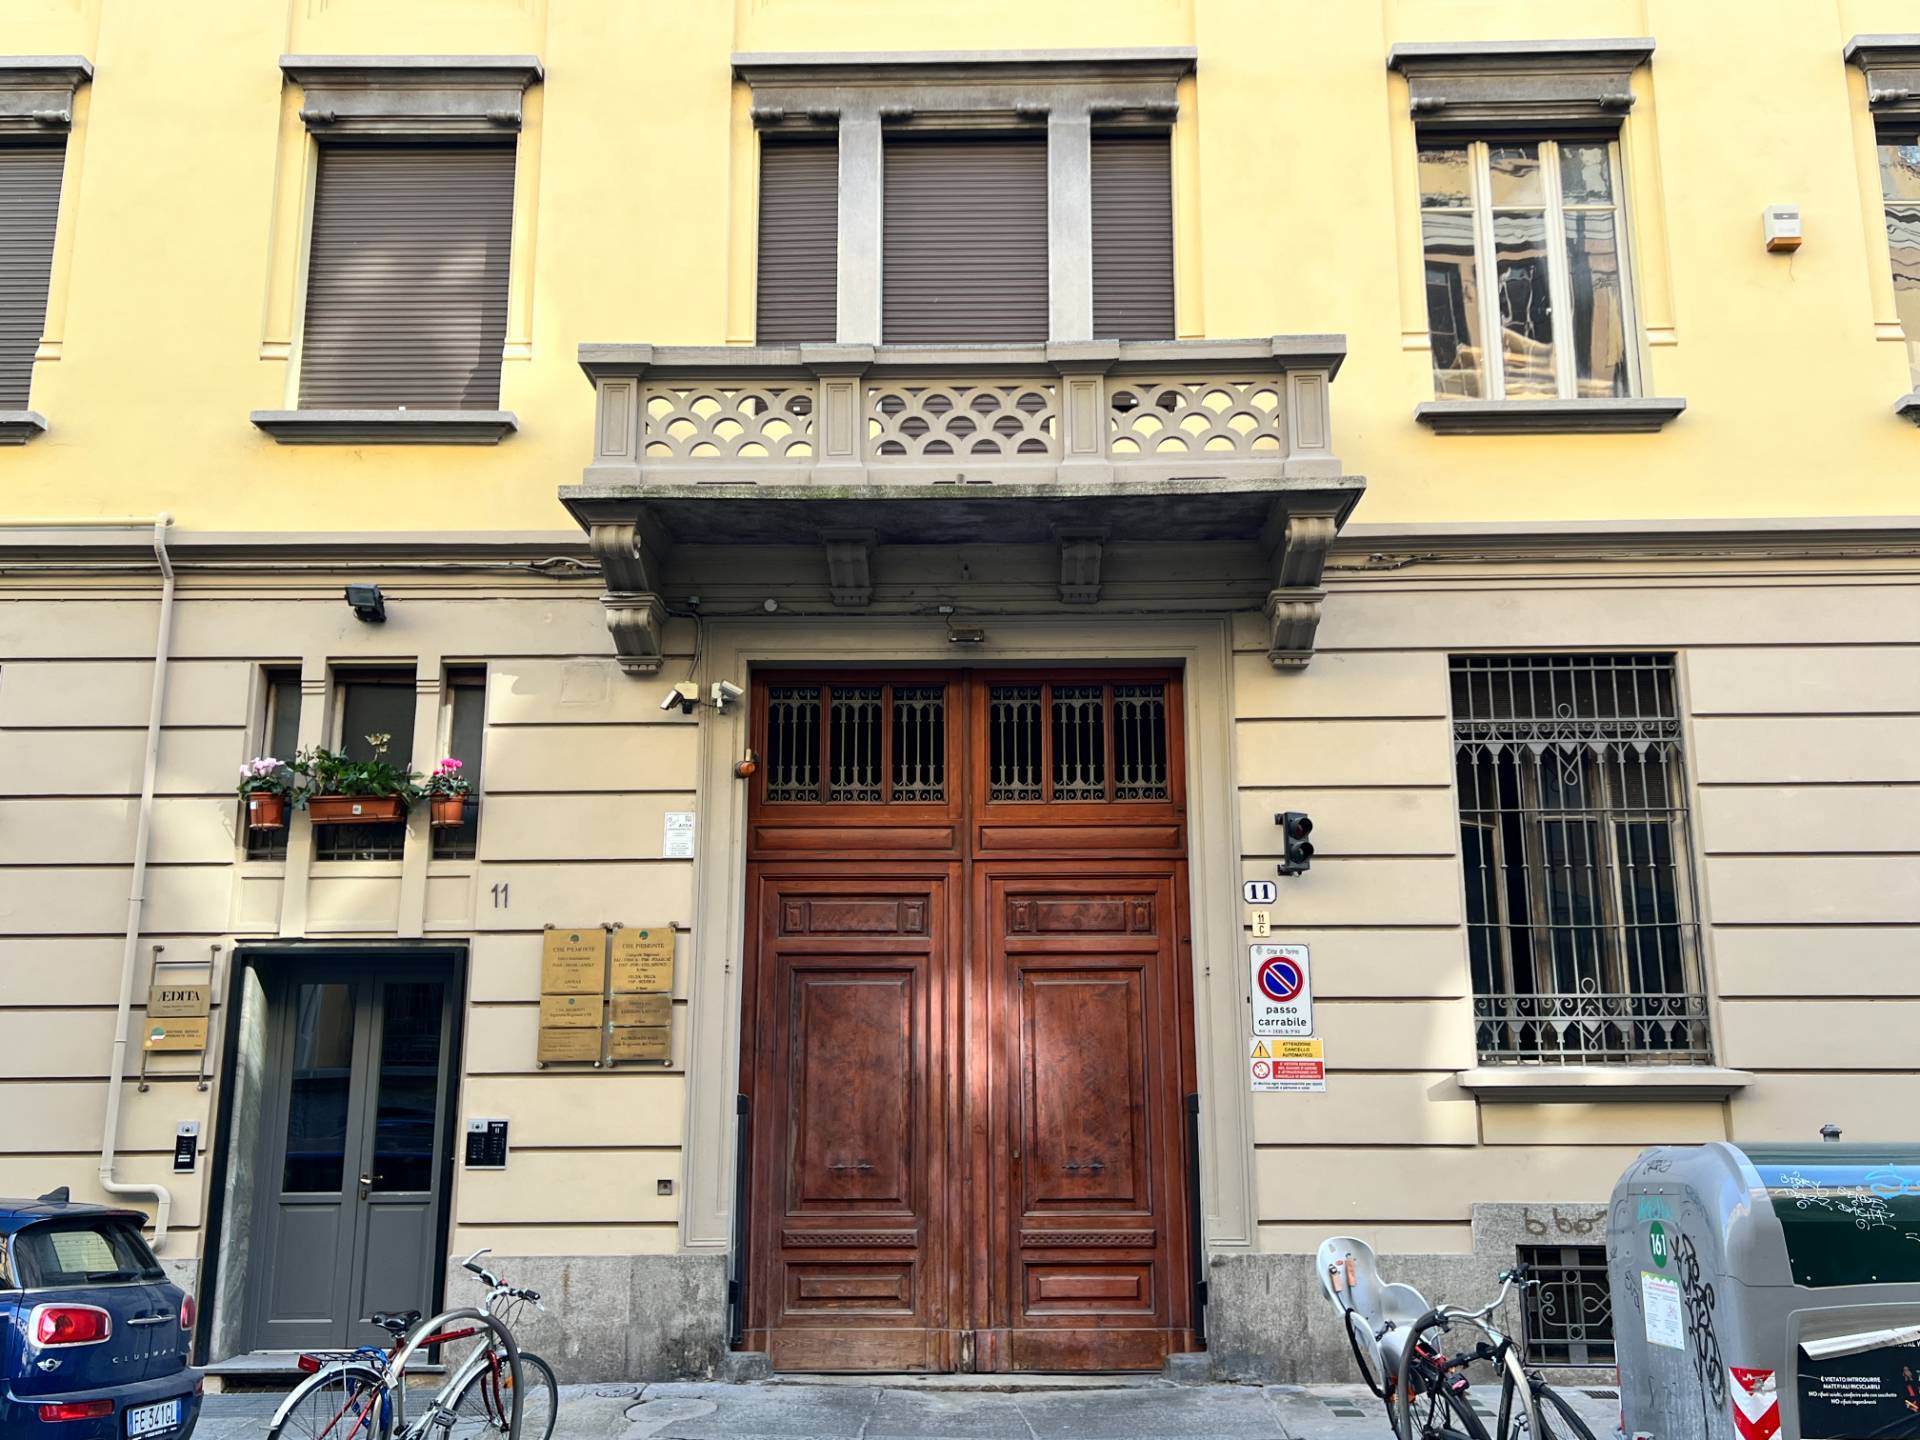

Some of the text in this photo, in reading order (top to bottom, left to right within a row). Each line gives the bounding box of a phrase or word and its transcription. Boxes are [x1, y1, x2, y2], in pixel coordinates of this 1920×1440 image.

[491, 883, 509, 908] 11
[1251, 884, 1270, 900] 11
[1266, 1006, 1297, 1015] passo
[1258, 1017, 1307, 1027] carrabile
[1651, 1234, 1666, 1256] 161
[134, 1409, 146, 1435] FE
